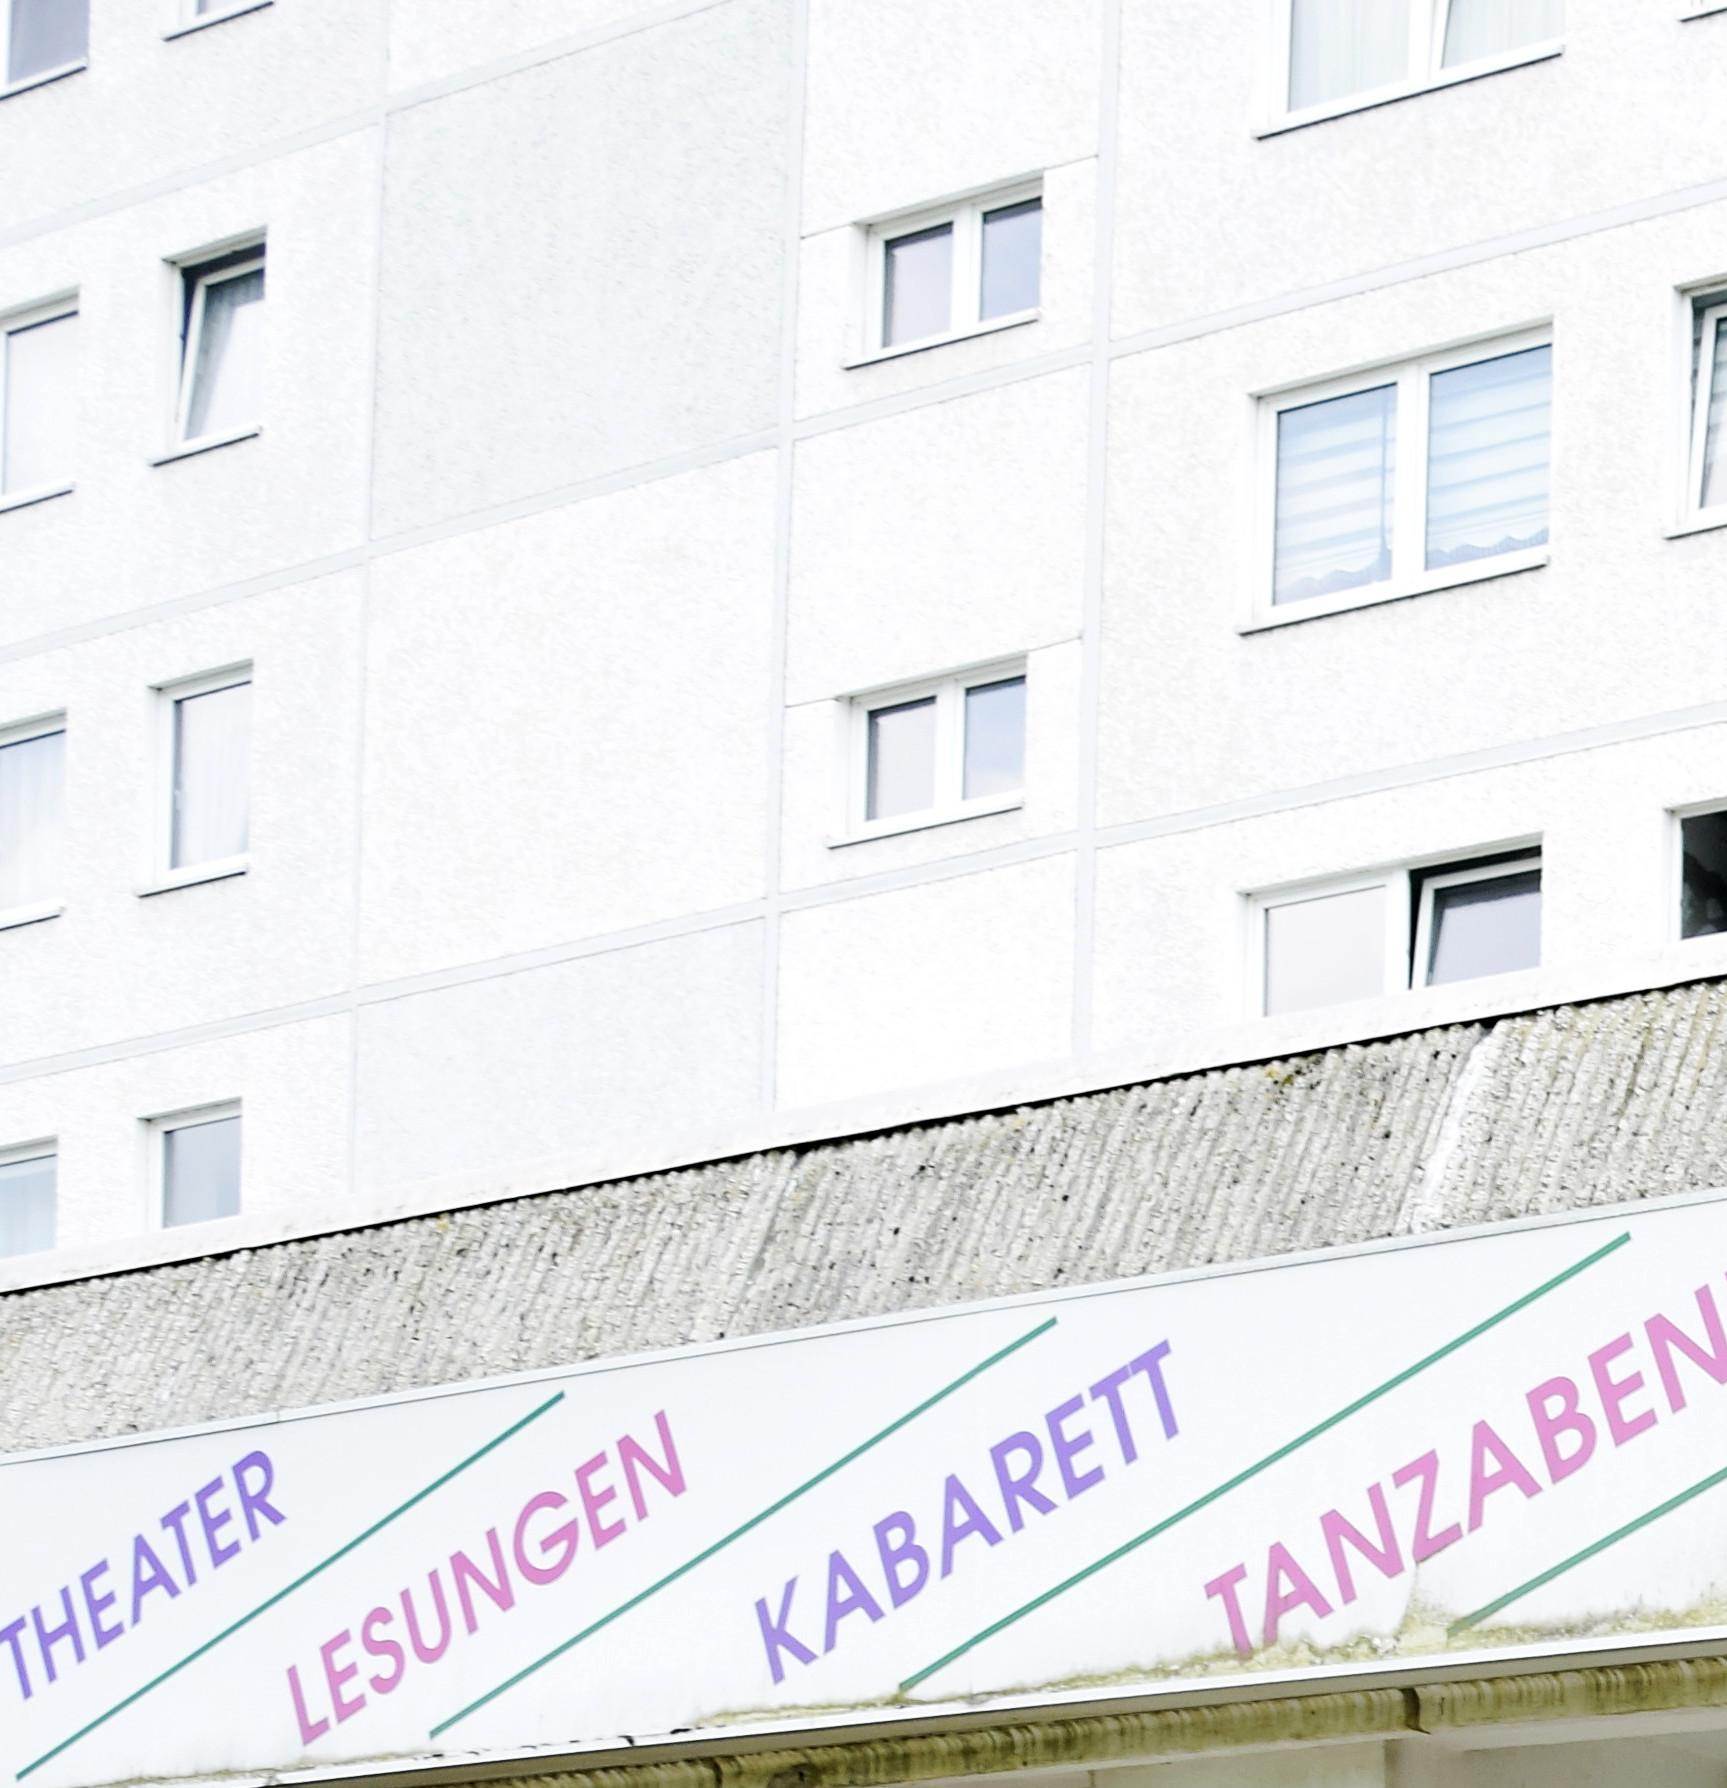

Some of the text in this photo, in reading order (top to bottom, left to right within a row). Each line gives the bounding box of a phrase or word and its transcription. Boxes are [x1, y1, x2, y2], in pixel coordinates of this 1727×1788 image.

[0, 1450, 288, 1702] THEATER
[286, 1409, 690, 1747] LESUNGEN
[753, 1338, 1187, 1686] KABARETT
